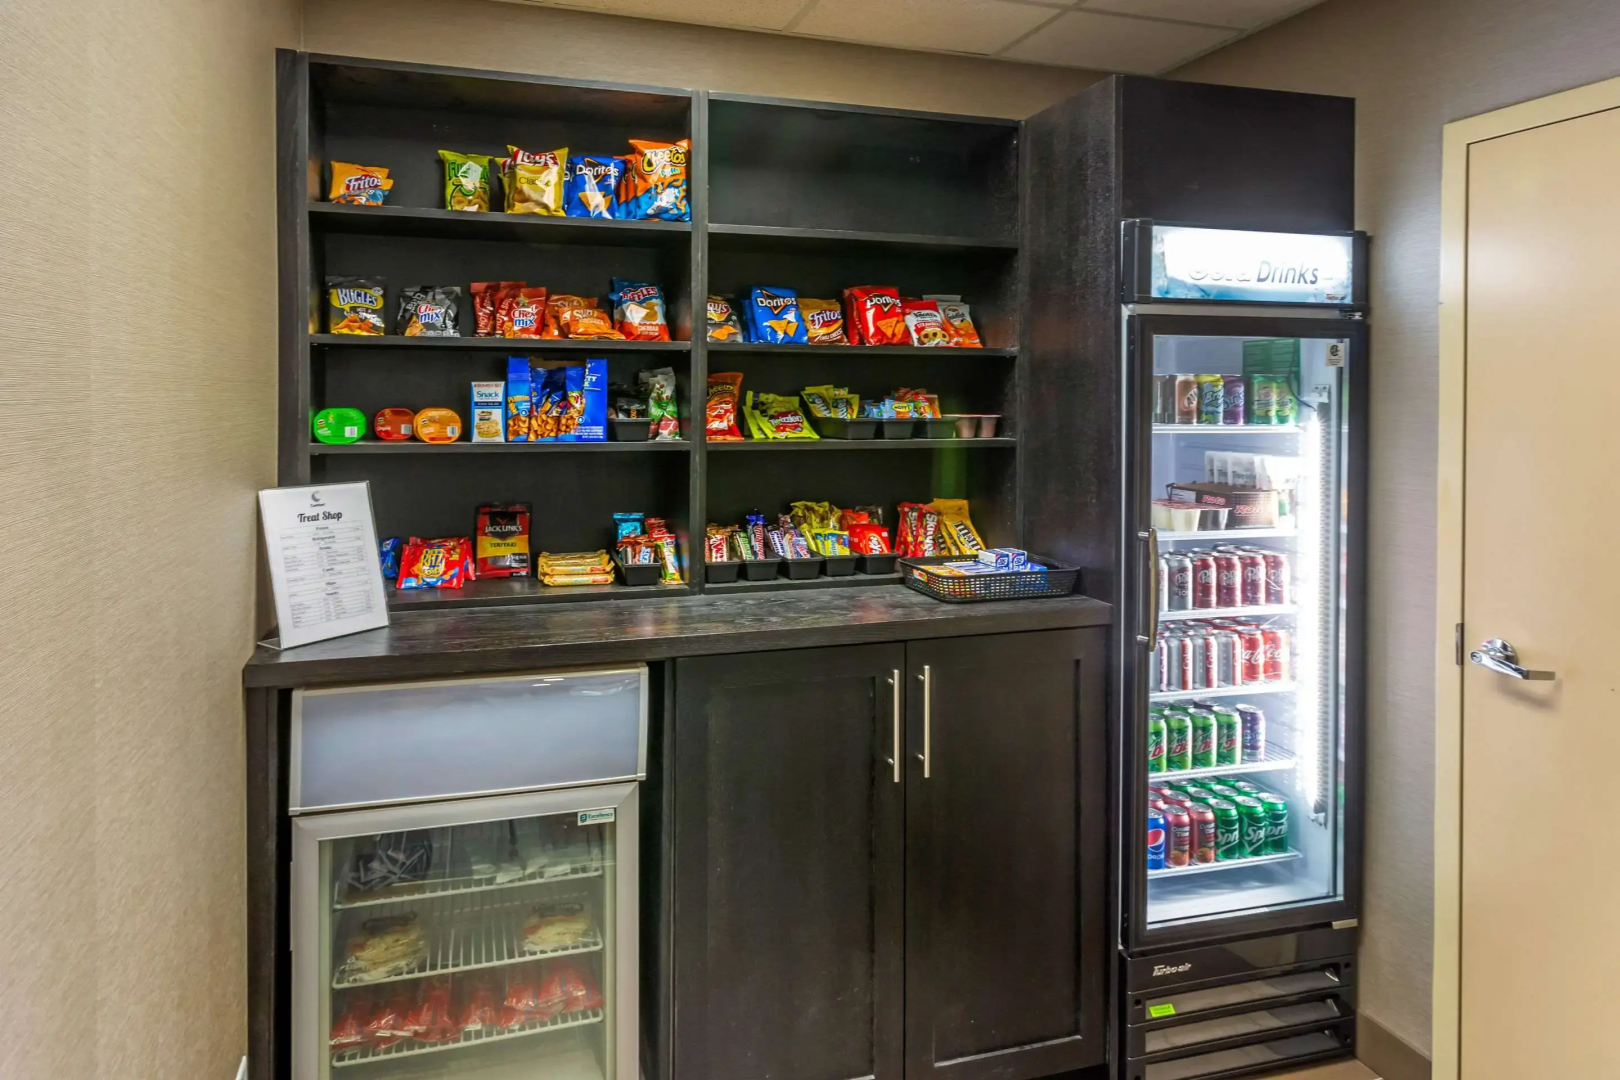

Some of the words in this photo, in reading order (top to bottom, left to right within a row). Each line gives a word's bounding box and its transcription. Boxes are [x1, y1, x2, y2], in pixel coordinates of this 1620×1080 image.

[641, 147, 687, 175] Cheetos
[576, 164, 619, 177] Doritos
[345, 174, 382, 191] Fritos
[1256, 260, 1319, 285] Drinks
[337, 288, 378, 307] BUGLES
[756, 297, 797, 307] Doritos
[420, 311, 442, 323] mix
[514, 318, 536, 328] mix
[808, 310, 842, 329] Fritos
[708, 384, 735, 397] heetos
[769, 413, 804, 424] Twizzlers
[297, 512, 320, 523] Treat
[322, 510, 343, 521] Shop
[484, 525, 502, 533] JACK
[1152, 964, 1178, 977] Turbo
